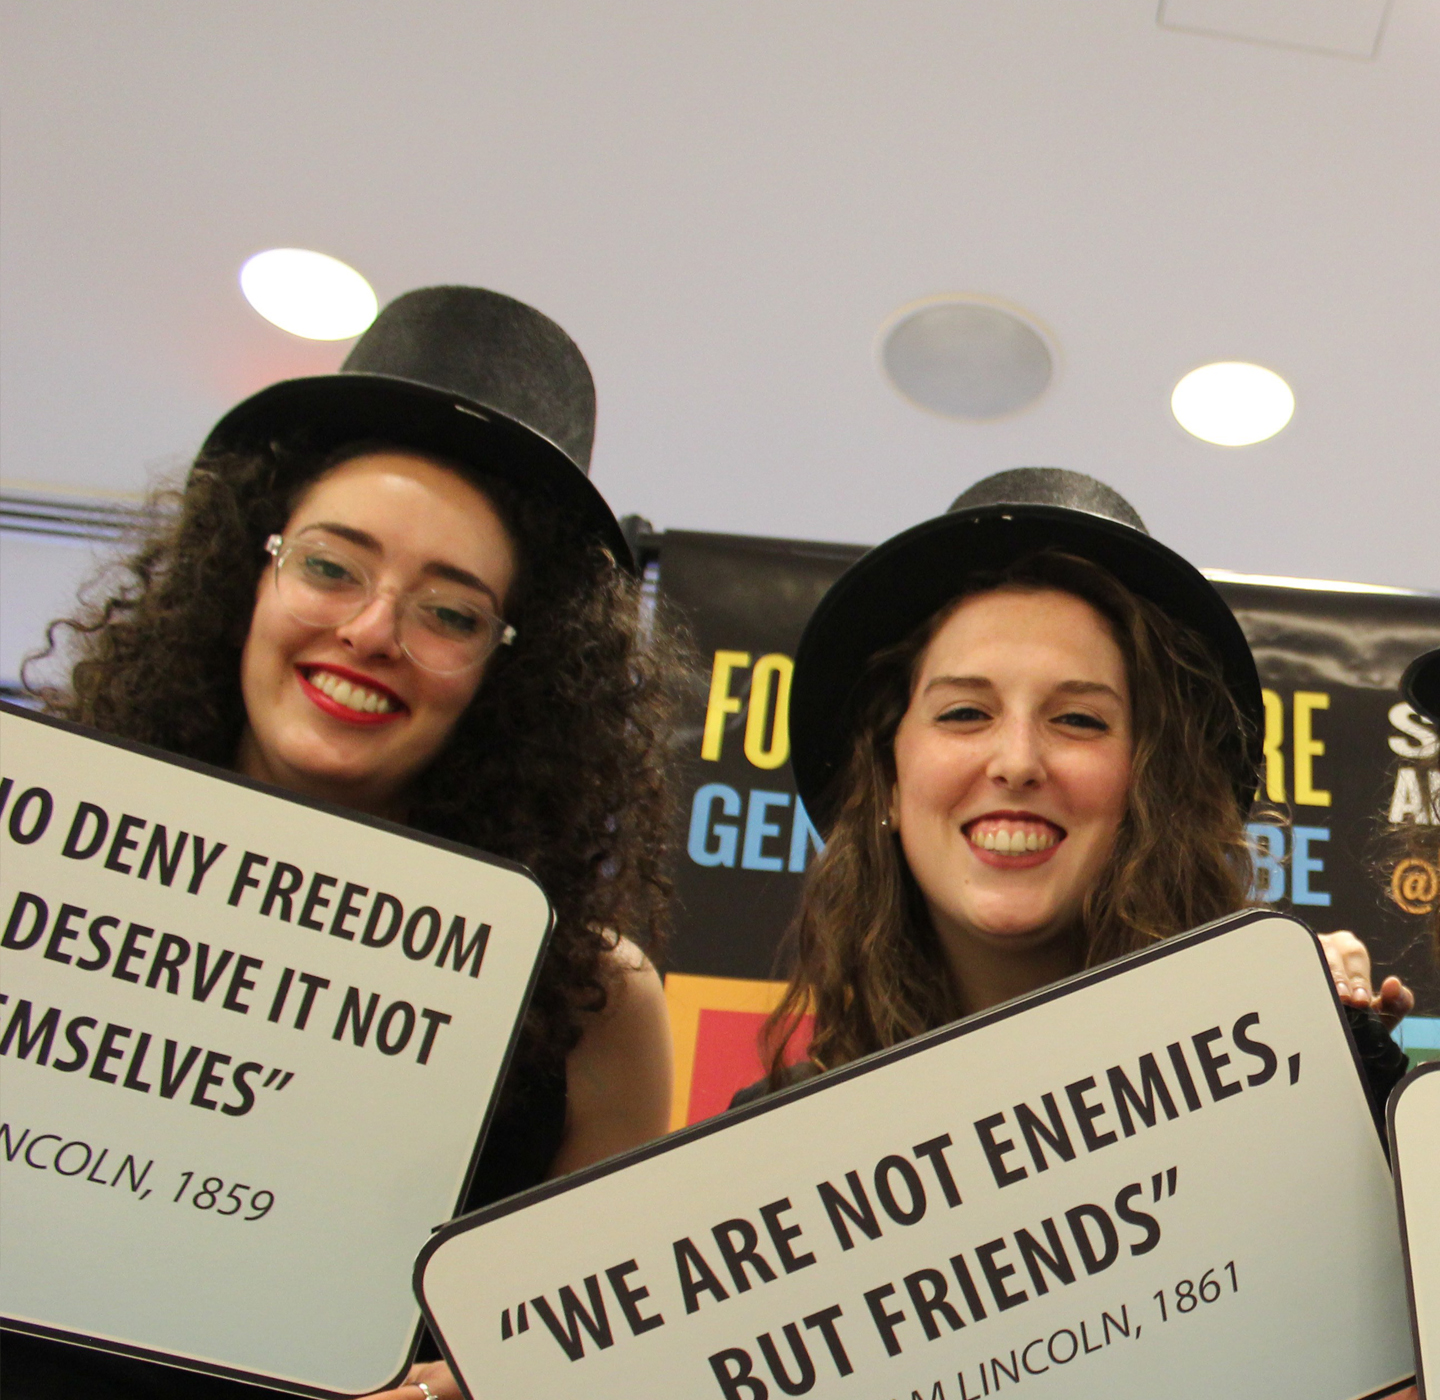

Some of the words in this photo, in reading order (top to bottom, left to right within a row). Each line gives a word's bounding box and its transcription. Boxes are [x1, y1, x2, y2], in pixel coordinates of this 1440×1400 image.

[0, 777, 54, 845] O
[61, 801, 228, 895] DENY
[227, 850, 492, 979] FREEDOM
[0, 891, 264, 1015] DESERVE
[267, 967, 331, 1031] IT
[332, 986, 453, 1066] NOT
[0, 993, 295, 1117] MSELVES”
[173, 1171, 275, 1222] 1859
[501, 1258, 665, 1362] “WE
[672, 1197, 817, 1315] ARE
[816, 1132, 963, 1252] NOT
[973, 1011, 1301, 1189] ENEMIES,
[708, 1303, 854, 1400] BUT
[863, 1166, 1178, 1358] FRIENDS”
[957, 1304, 1142, 1400] LINCOLN,
[1153, 1260, 1240, 1323] 1861
